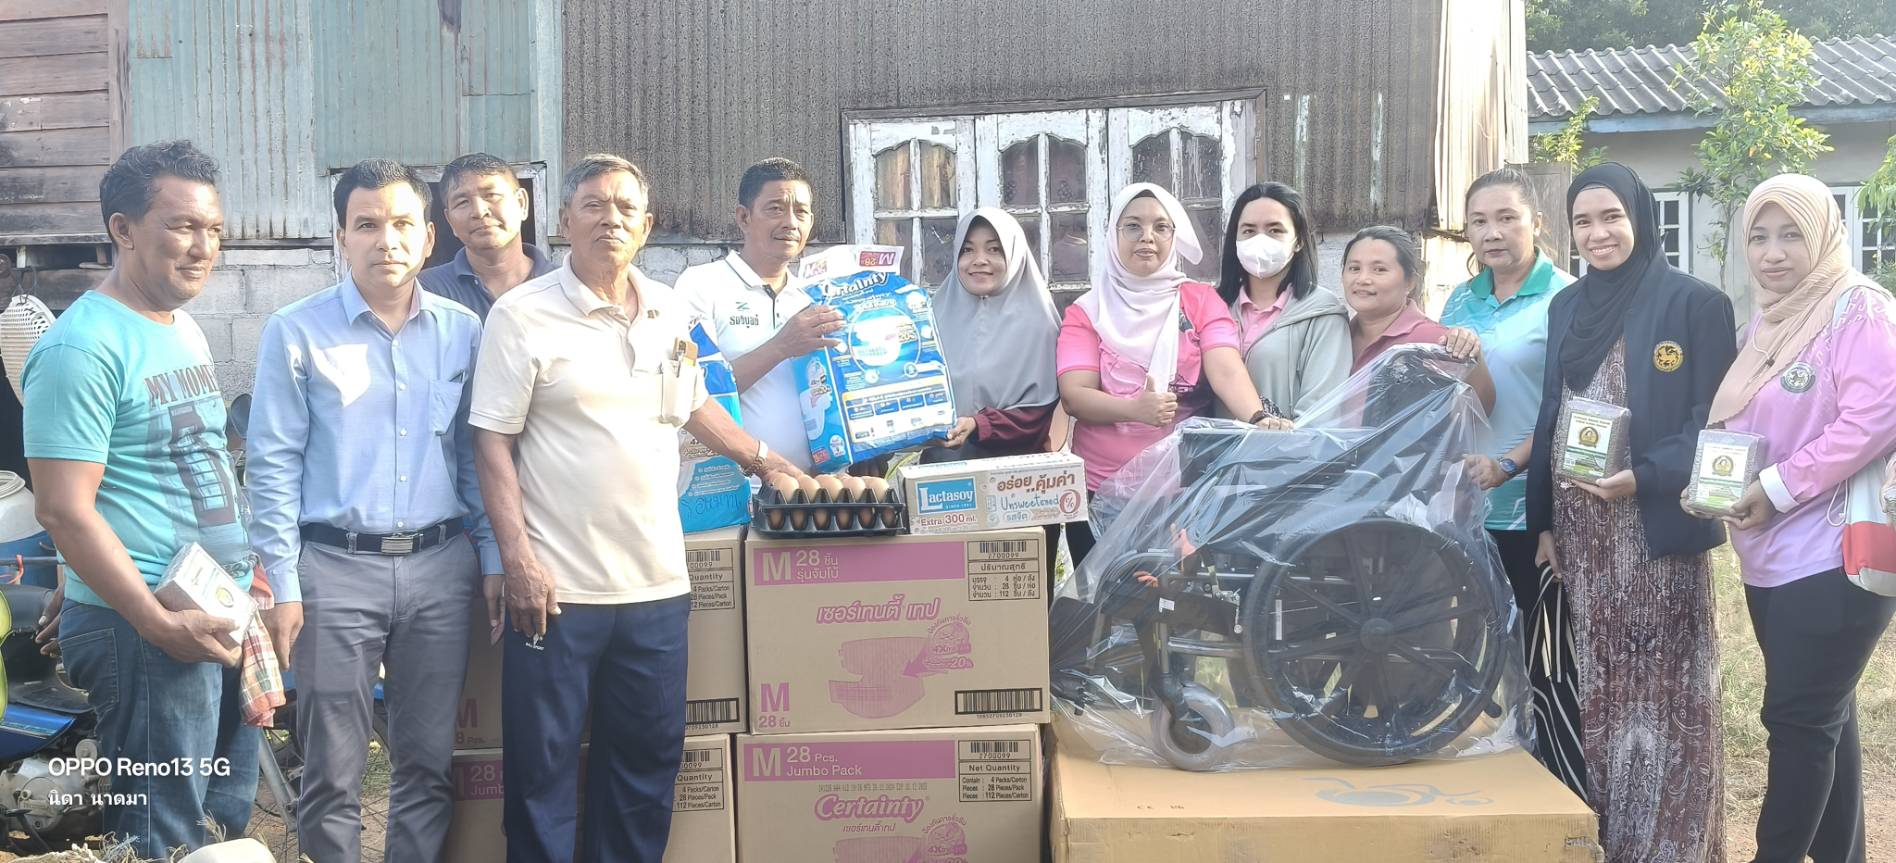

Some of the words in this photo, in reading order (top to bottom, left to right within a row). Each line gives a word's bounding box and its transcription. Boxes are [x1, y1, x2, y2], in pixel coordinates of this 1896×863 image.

[878, 253, 894, 265] M
[144, 373, 178, 408] MY
[997, 474, 1032, 491] อร่อย
[918, 487, 976, 511] Lactasoy
[921, 517, 943, 527] Extra
[944, 513, 965, 524] 300
[795, 550, 820, 566] 28
[823, 552, 839, 566] ชิ้น
[762, 552, 791, 581] M
[816, 594, 905, 624] เซอร์เทนตี้
[906, 597, 941, 621] เทป
[761, 682, 790, 712] M
[759, 715, 776, 728] 28
[752, 747, 780, 776] M
[786, 746, 810, 762] 28
[815, 753, 838, 762] Pcs.
[471, 764, 496, 782] 28
[786, 765, 829, 776] Jumbo
[832, 764, 862, 776] Pack
[985, 764, 1020, 772] Quantity
[677, 774, 713, 782] Quantity
[471, 784, 504, 796] Jumb
[815, 794, 924, 823] Certainty
